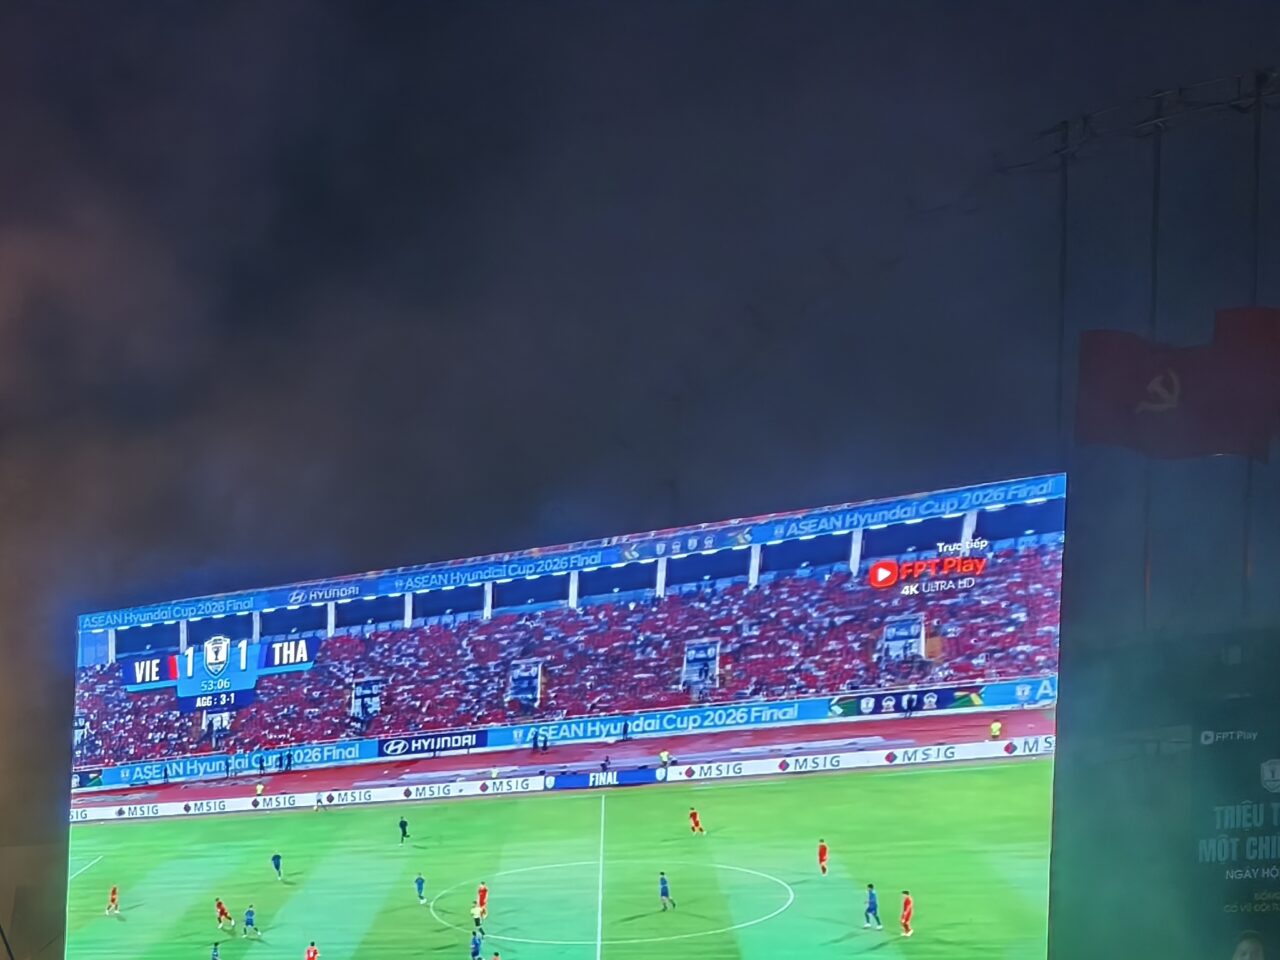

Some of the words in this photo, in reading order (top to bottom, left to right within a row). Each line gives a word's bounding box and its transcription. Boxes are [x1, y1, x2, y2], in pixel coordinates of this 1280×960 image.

[787, 517, 841, 536] ASEAN
[842, 501, 916, 532] Hyundai
[920, 498, 959, 518] Cup
[962, 488, 1006, 507] 2026
[1010, 481, 1055, 501] Final
[404, 574, 448, 590] ASEAN
[450, 565, 507, 585] Hyundai
[509, 562, 535, 579] Cup
[535, 558, 568, 574] 2026
[570, 550, 601, 568] Final
[900, 560, 941, 580] FPT
[944, 555, 987, 577] Play
[310, 585, 360, 601] HYUNDAI
[901, 583, 920, 596] 4K
[922, 579, 955, 593] ULTRA
[956, 577, 976, 590] HD
[83, 613, 123, 629] ASEAN
[123, 608, 172, 628] Hyundai
[173, 604, 197, 620] Cup
[226, 597, 254, 612] Final
[238, 640, 248, 670] 1
[272, 640, 308, 665] THA
[185, 647, 195, 677] 1
[135, 659, 161, 683] VIE
[590, 718, 661, 738] Hyundai
[663, 712, 701, 731] Cup
[703, 707, 748, 726] 2026
[751, 704, 799, 721] Final
[411, 734, 477, 751] HYUNDAI
[324, 744, 360, 761] Final
[903, 746, 956, 763] MSIG
[699, 762, 743, 777] MSIG
[794, 755, 840, 770] MSIG
[491, 778, 529, 792] MSIG
[589, 771, 619, 786] FINAL
[337, 790, 372, 803] MSIG
[415, 784, 451, 798] MSIG
[127, 805, 159, 817] MSIG
[194, 800, 227, 814] MSIG
[262, 796, 296, 809] MSIG
